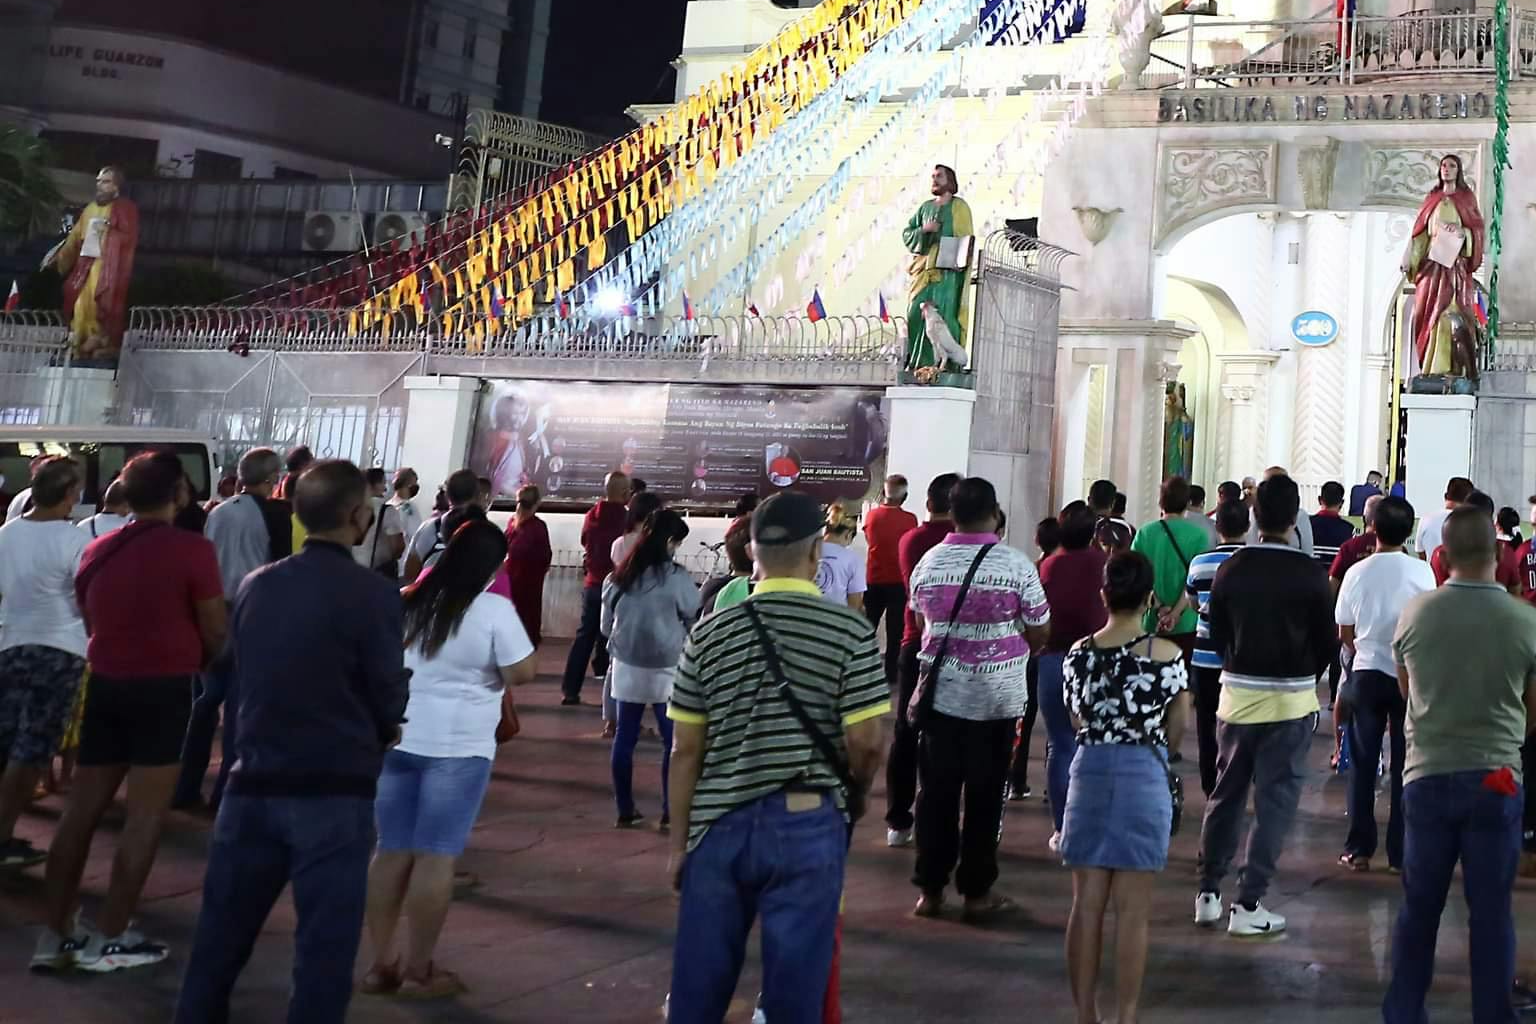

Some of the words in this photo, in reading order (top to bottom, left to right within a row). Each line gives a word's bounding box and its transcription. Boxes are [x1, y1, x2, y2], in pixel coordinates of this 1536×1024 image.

[93, 48, 164, 69] GUANZON
[1158, 95, 1277, 122] BASILIKA
[1295, 94, 1328, 121] NG
[1343, 91, 1491, 121] NAZARENO
